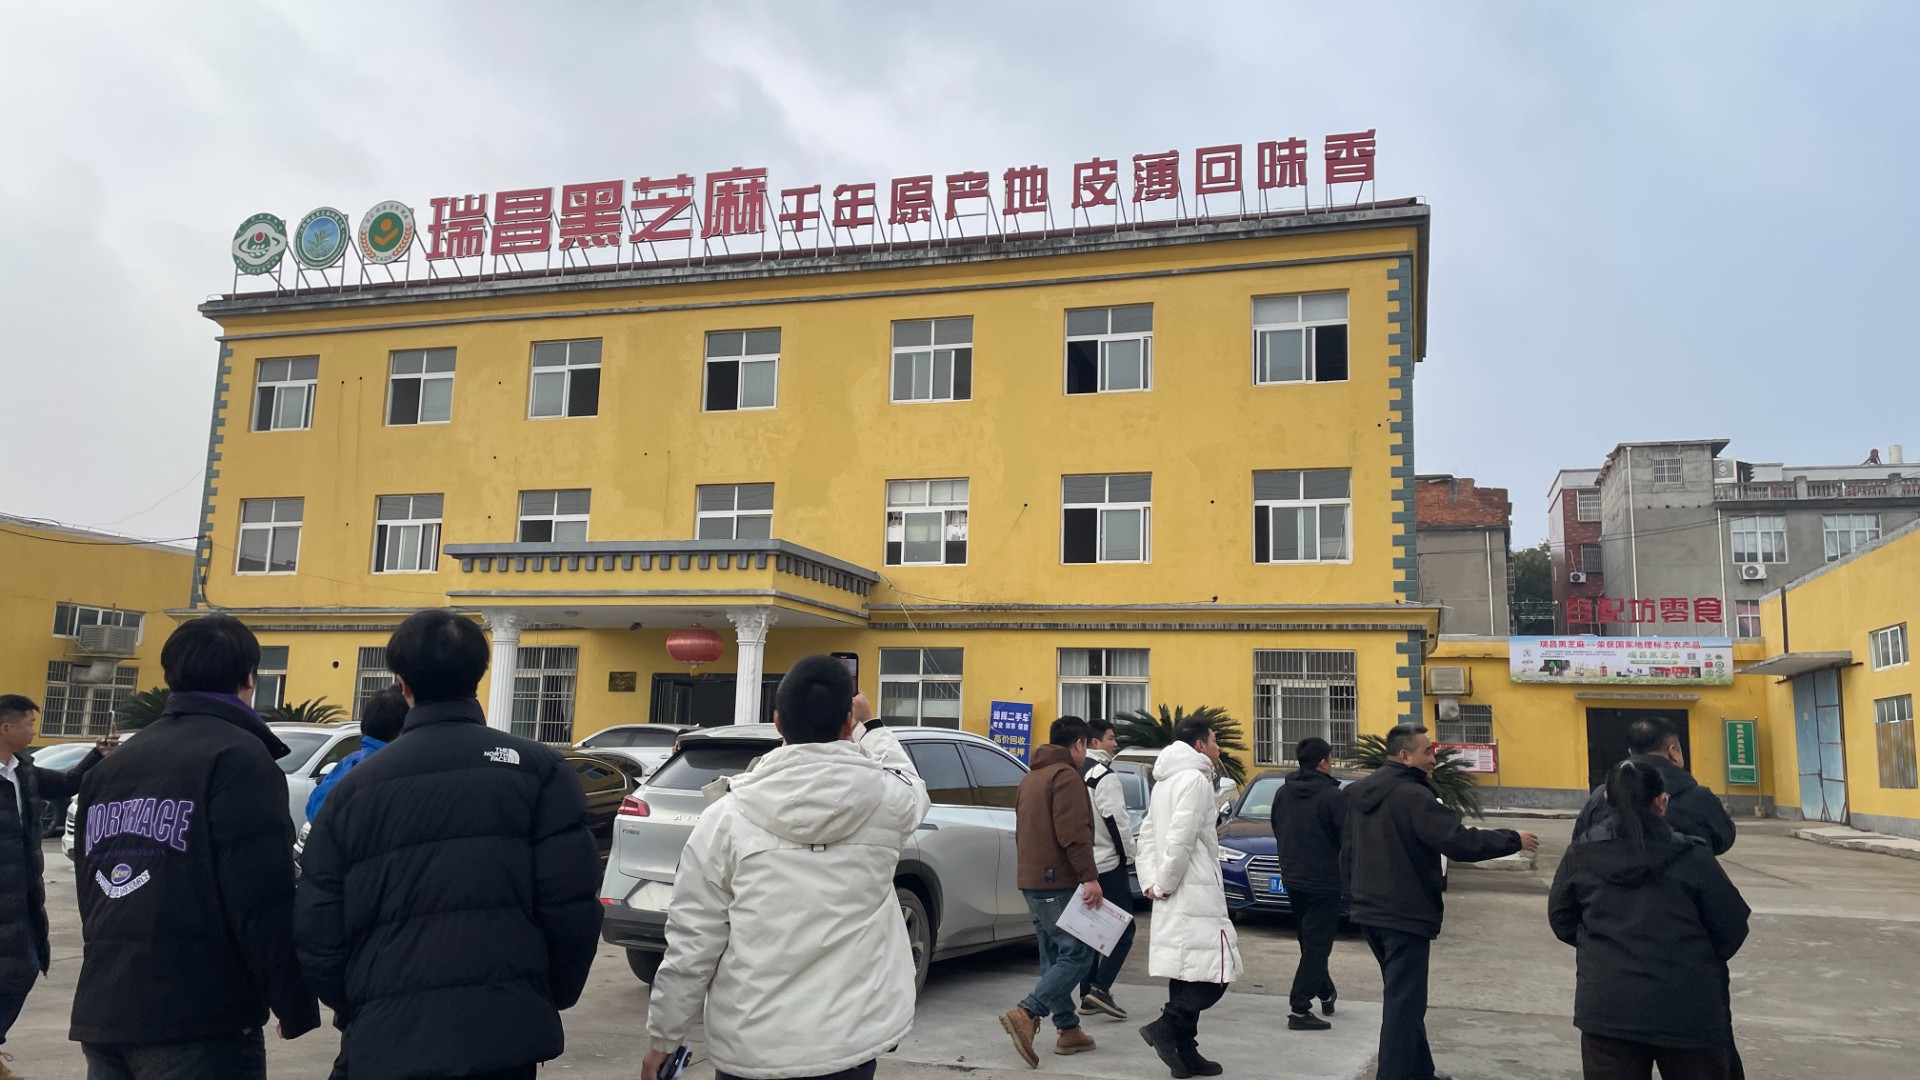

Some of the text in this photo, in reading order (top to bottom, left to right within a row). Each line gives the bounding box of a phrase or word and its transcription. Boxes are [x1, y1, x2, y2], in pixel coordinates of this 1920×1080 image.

[425, 166, 768, 261] 瑞昌黑芝麻
[779, 170, 1048, 233] 千年原产地
[1071, 129, 1376, 209] 皮薄回味香
[994, 734, 1026, 745] 高价回收
